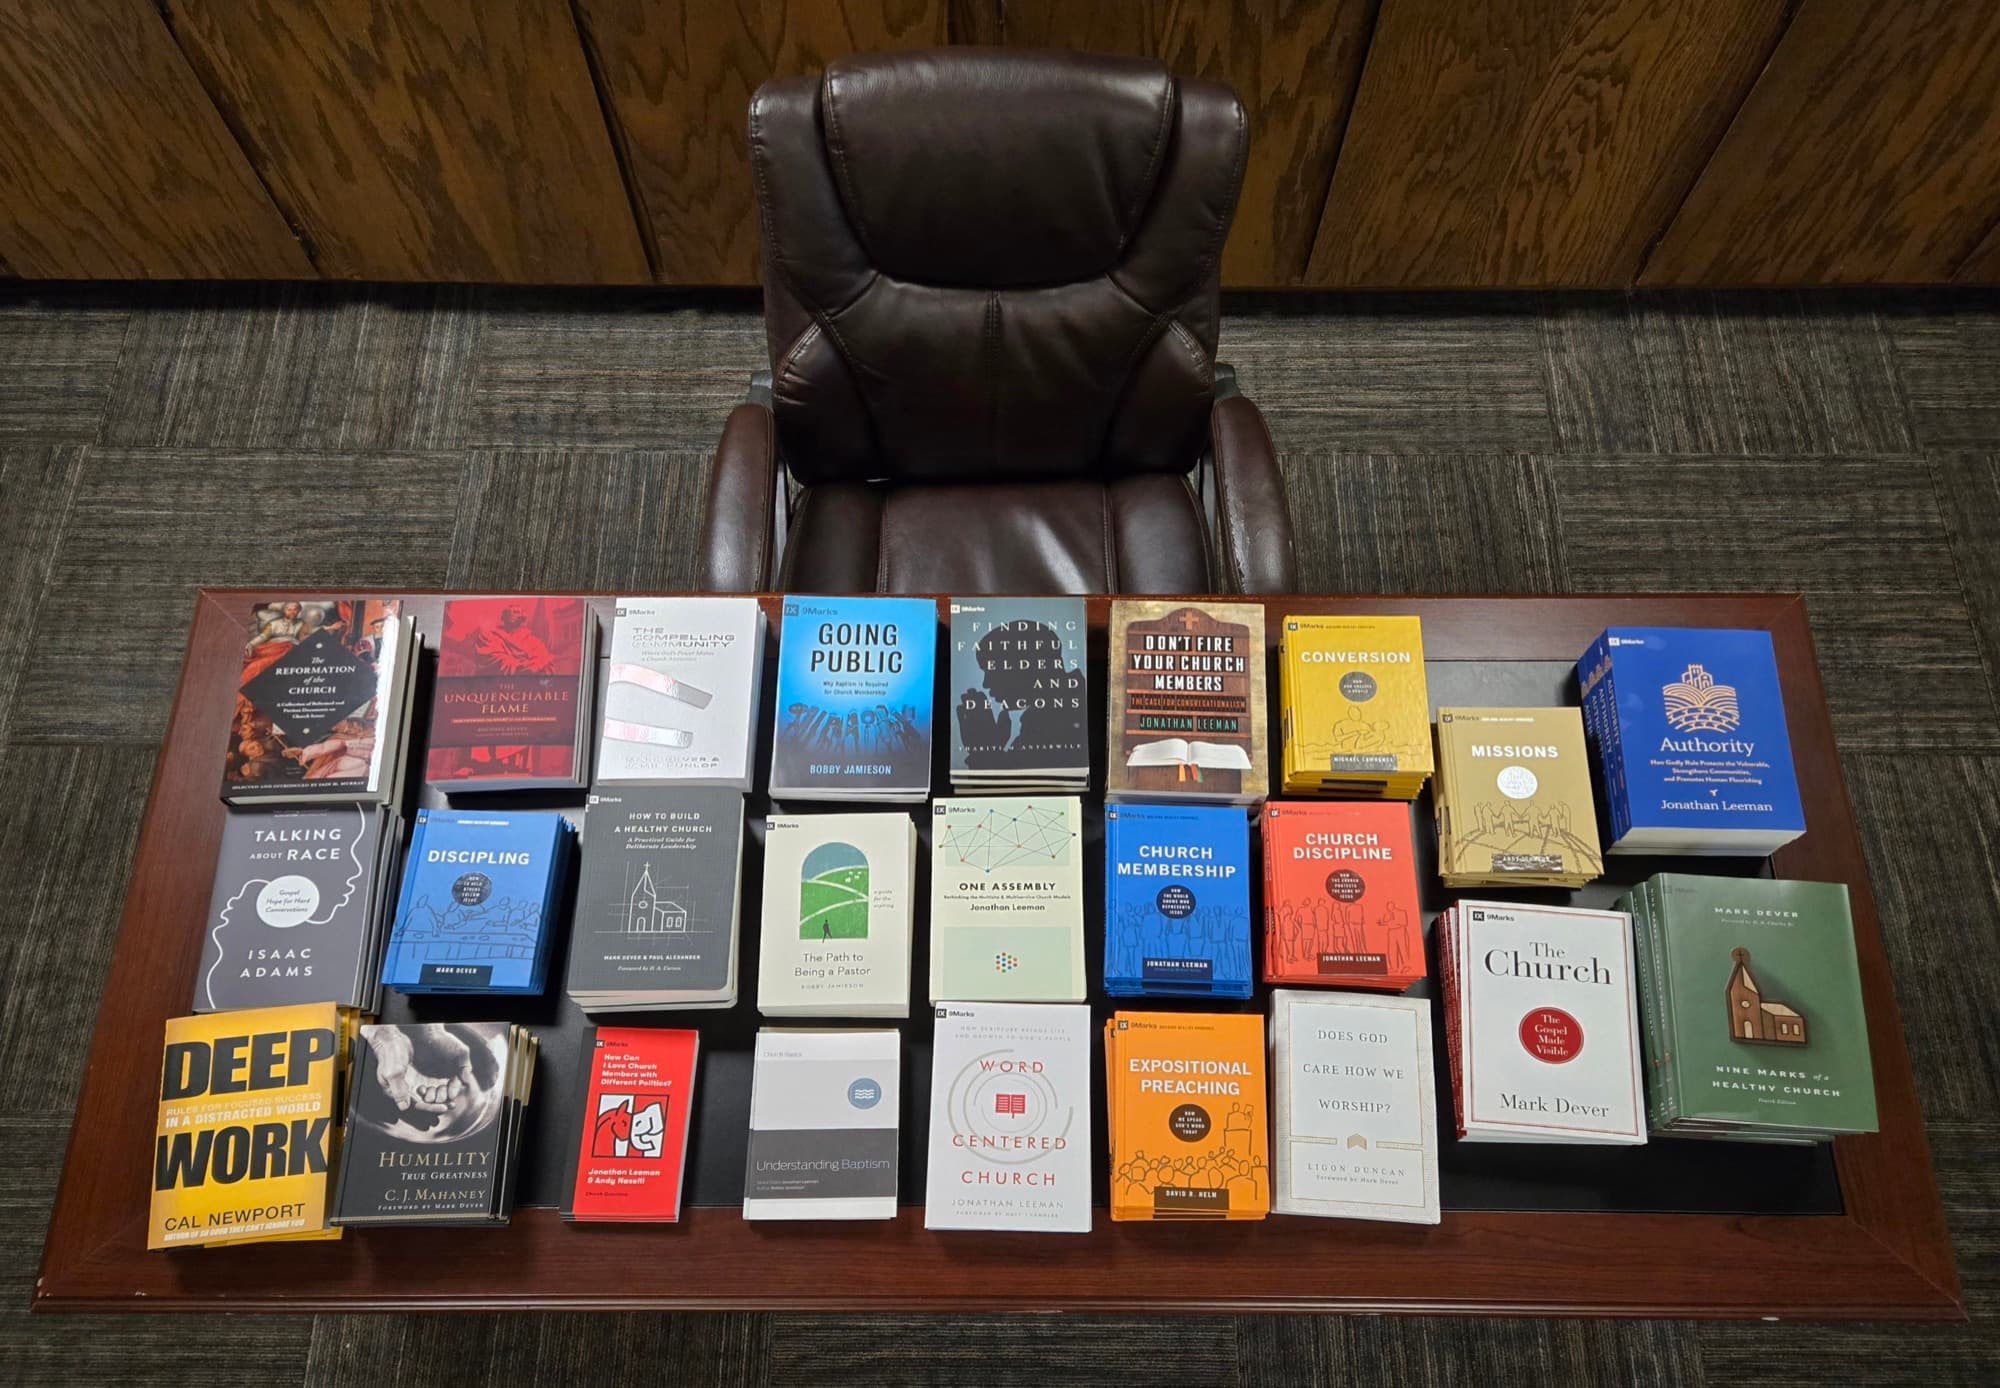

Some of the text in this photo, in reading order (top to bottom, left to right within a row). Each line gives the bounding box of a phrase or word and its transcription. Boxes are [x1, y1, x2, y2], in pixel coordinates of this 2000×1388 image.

[803, 607, 838, 615] 9Marks
[972, 621, 1077, 632] FINDING
[819, 623, 897, 646] GOING
[957, 640, 1078, 651] FAITHFUL
[1145, 635, 1232, 652] DON'T FIRE
[810, 650, 903, 673] PUBLIC
[1133, 655, 1244, 672] YOUR CHURCH
[1301, 651, 1411, 663] CONVERSION
[275, 666, 356, 675] REFORMATION
[987, 659, 1078, 671] ELDERS
[303, 677, 313, 685] of
[1034, 678, 1079, 689] AND
[1155, 675, 1222, 691] MEMBERS
[288, 686, 336, 695] CHURCH
[445, 691, 569, 704] UNQUENCHABLE
[966, 698, 1080, 710] DEACONS
[1132, 697, 1144, 705] THE
[1145, 698, 1161, 706] CASE
[482, 704, 529, 713] FLAME
[1607, 679, 1620, 745] AUTHORITY
[1140, 716, 1237, 731] JONATHAN LEEMAN
[1471, 745, 1558, 758] MISSIONS
[1660, 736, 1755, 757] Authority
[810, 764, 892, 775] BOBBY JAMIESON
[1661, 800, 1773, 812] Jonathan Leeman
[629, 812, 701, 820] HOW TO BUILD
[254, 829, 342, 842] TALKING
[1306, 833, 1378, 845] CHURCH
[249, 848, 341, 861] ABOUT RACE
[428, 850, 530, 865] DISCIPLING
[1139, 845, 1213, 859] CHURCH
[1293, 848, 1392, 860] DISCIPLINE
[1117, 863, 1236, 878] MEMBERSHIP
[959, 882, 1056, 891] ONE ASSEMBLY
[970, 904, 1045, 912] Jonathan Leeman
[1715, 907, 1800, 918] MARK DEVER
[1487, 913, 1515, 922] 9Marks
[248, 948, 312, 960] ISAAC
[1529, 942, 1565, 958] The
[803, 952, 863, 963] The Path to
[240, 966, 313, 978] ADAMS
[794, 967, 825, 978] Being
[837, 966, 871, 976] Pastor
[1484, 948, 1613, 985] Church
[1541, 1013, 1560, 1024] The
[1534, 1024, 1568, 1036] Gospel
[1317, 1030, 1388, 1044] DOES GOD
[1538, 1034, 1565, 1045] Made
[1535, 1045, 1569, 1056] Visible
[161, 1028, 336, 1101] DEEP
[628, 1062, 657, 1070] Church
[980, 1060, 1044, 1073] WORD
[1130, 1059, 1252, 1075] EXPOSITIONAL
[1303, 1063, 1404, 1079] CARE HOW WE
[1716, 1066, 1750, 1075] NINE
[1757, 1068, 1806, 1079] MARKS
[1813, 1073, 1822, 1082] of
[1141, 1080, 1240, 1095] PREACHING
[1712, 1080, 1841, 1097] HEALTHY CHURCH
[166, 1092, 322, 1116] RULES FOR FOCUSED SUCCESS
[1319, 1099, 1391, 1113] WORSHIP?
[1500, 1093, 1609, 1118] Mark Dever
[166, 1101, 321, 1129] IN A DISTRACTED WORLD
[952, 1134, 1067, 1150] CENTERED
[155, 1117, 331, 1191] WORK
[379, 1151, 491, 1168] HUMILITY
[588, 1168, 661, 1176] Jonathan Leeman
[756, 1159, 890, 1172] Understanding Baptism
[1308, 1163, 1405, 1176] LIGON DUNCAN
[401, 1171, 488, 1181] TRUE GREATNESS
[594, 1178, 615, 1186] Andy
[961, 1170, 1056, 1186] CHURCH
[384, 1188, 486, 1203] C. J. MAHANEY
[952, 1199, 1064, 1209] JONATHAN LEEMAN
[164, 1203, 306, 1232] CAL NEWPORT
[164, 1232, 190, 1241] AUTHOR
